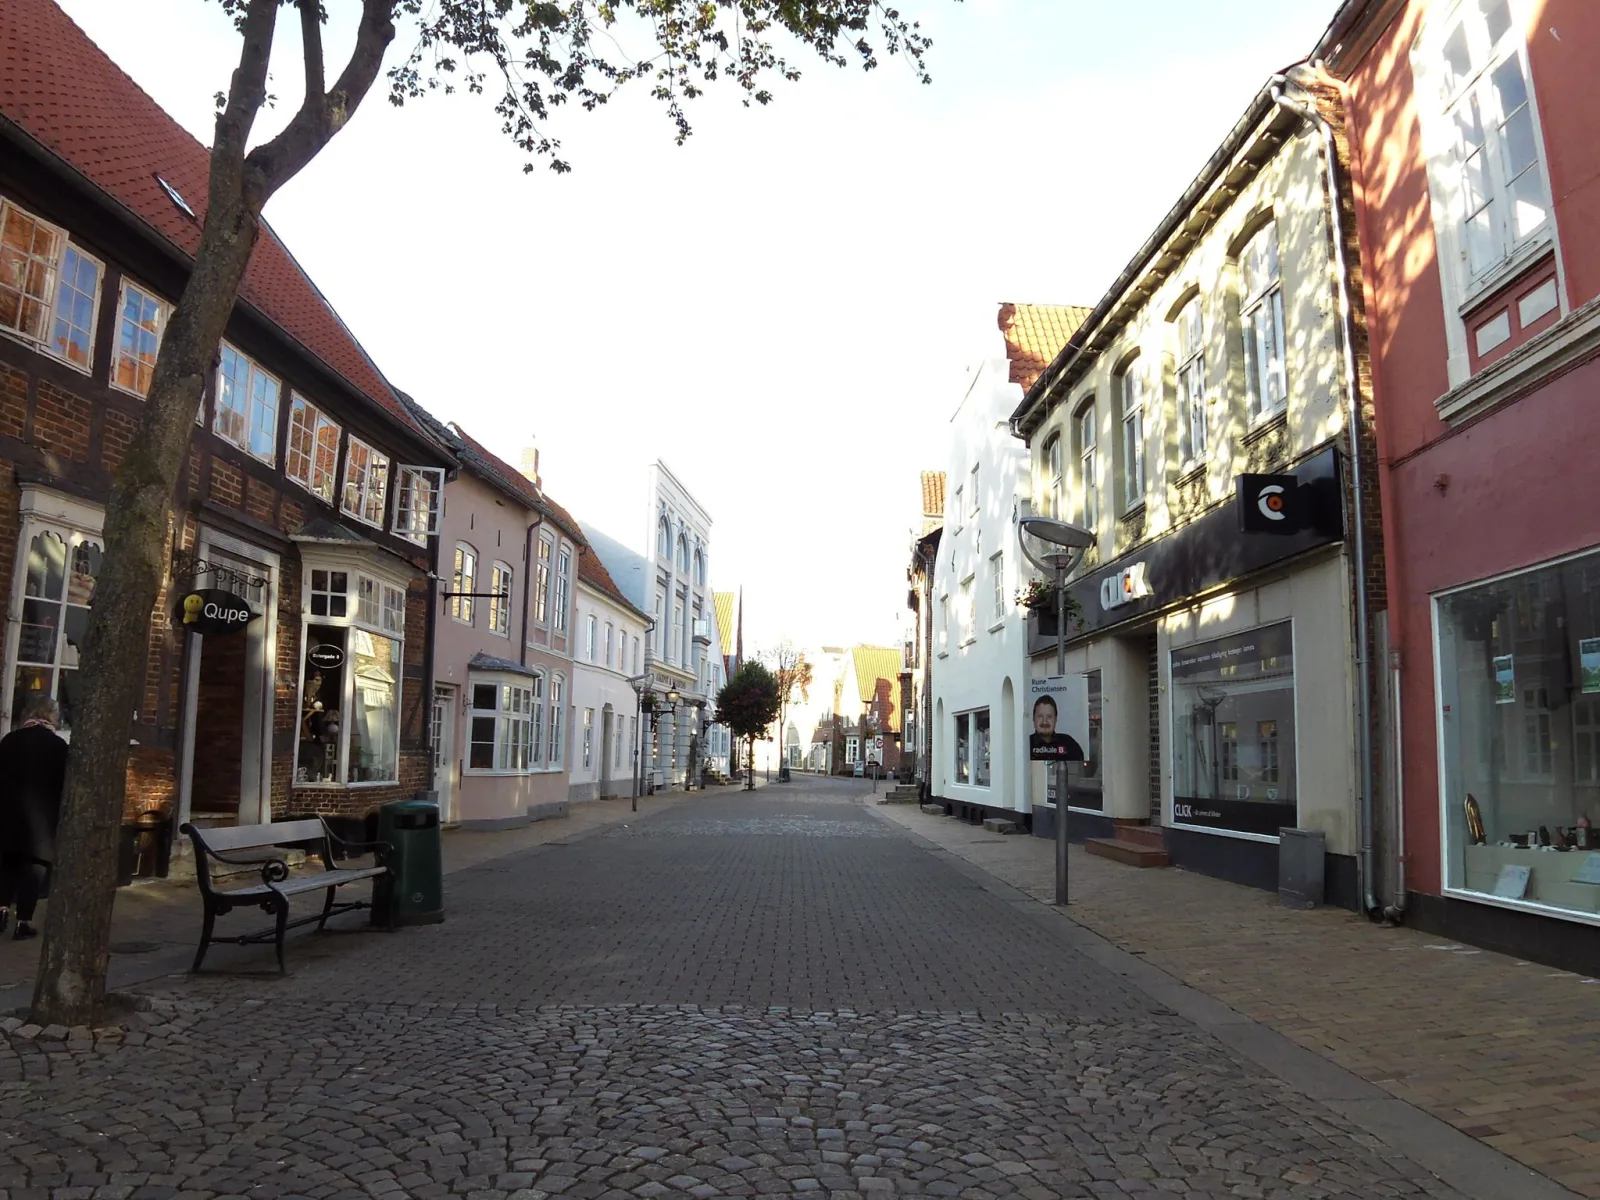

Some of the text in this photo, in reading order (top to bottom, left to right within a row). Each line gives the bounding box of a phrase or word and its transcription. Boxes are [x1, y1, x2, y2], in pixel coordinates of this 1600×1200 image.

[1100, 561, 1153, 611] CLICK
[204, 603, 249, 624] Qupe
[1032, 746, 1058, 754] radikale
[1174, 803, 1192, 817] CLICK
